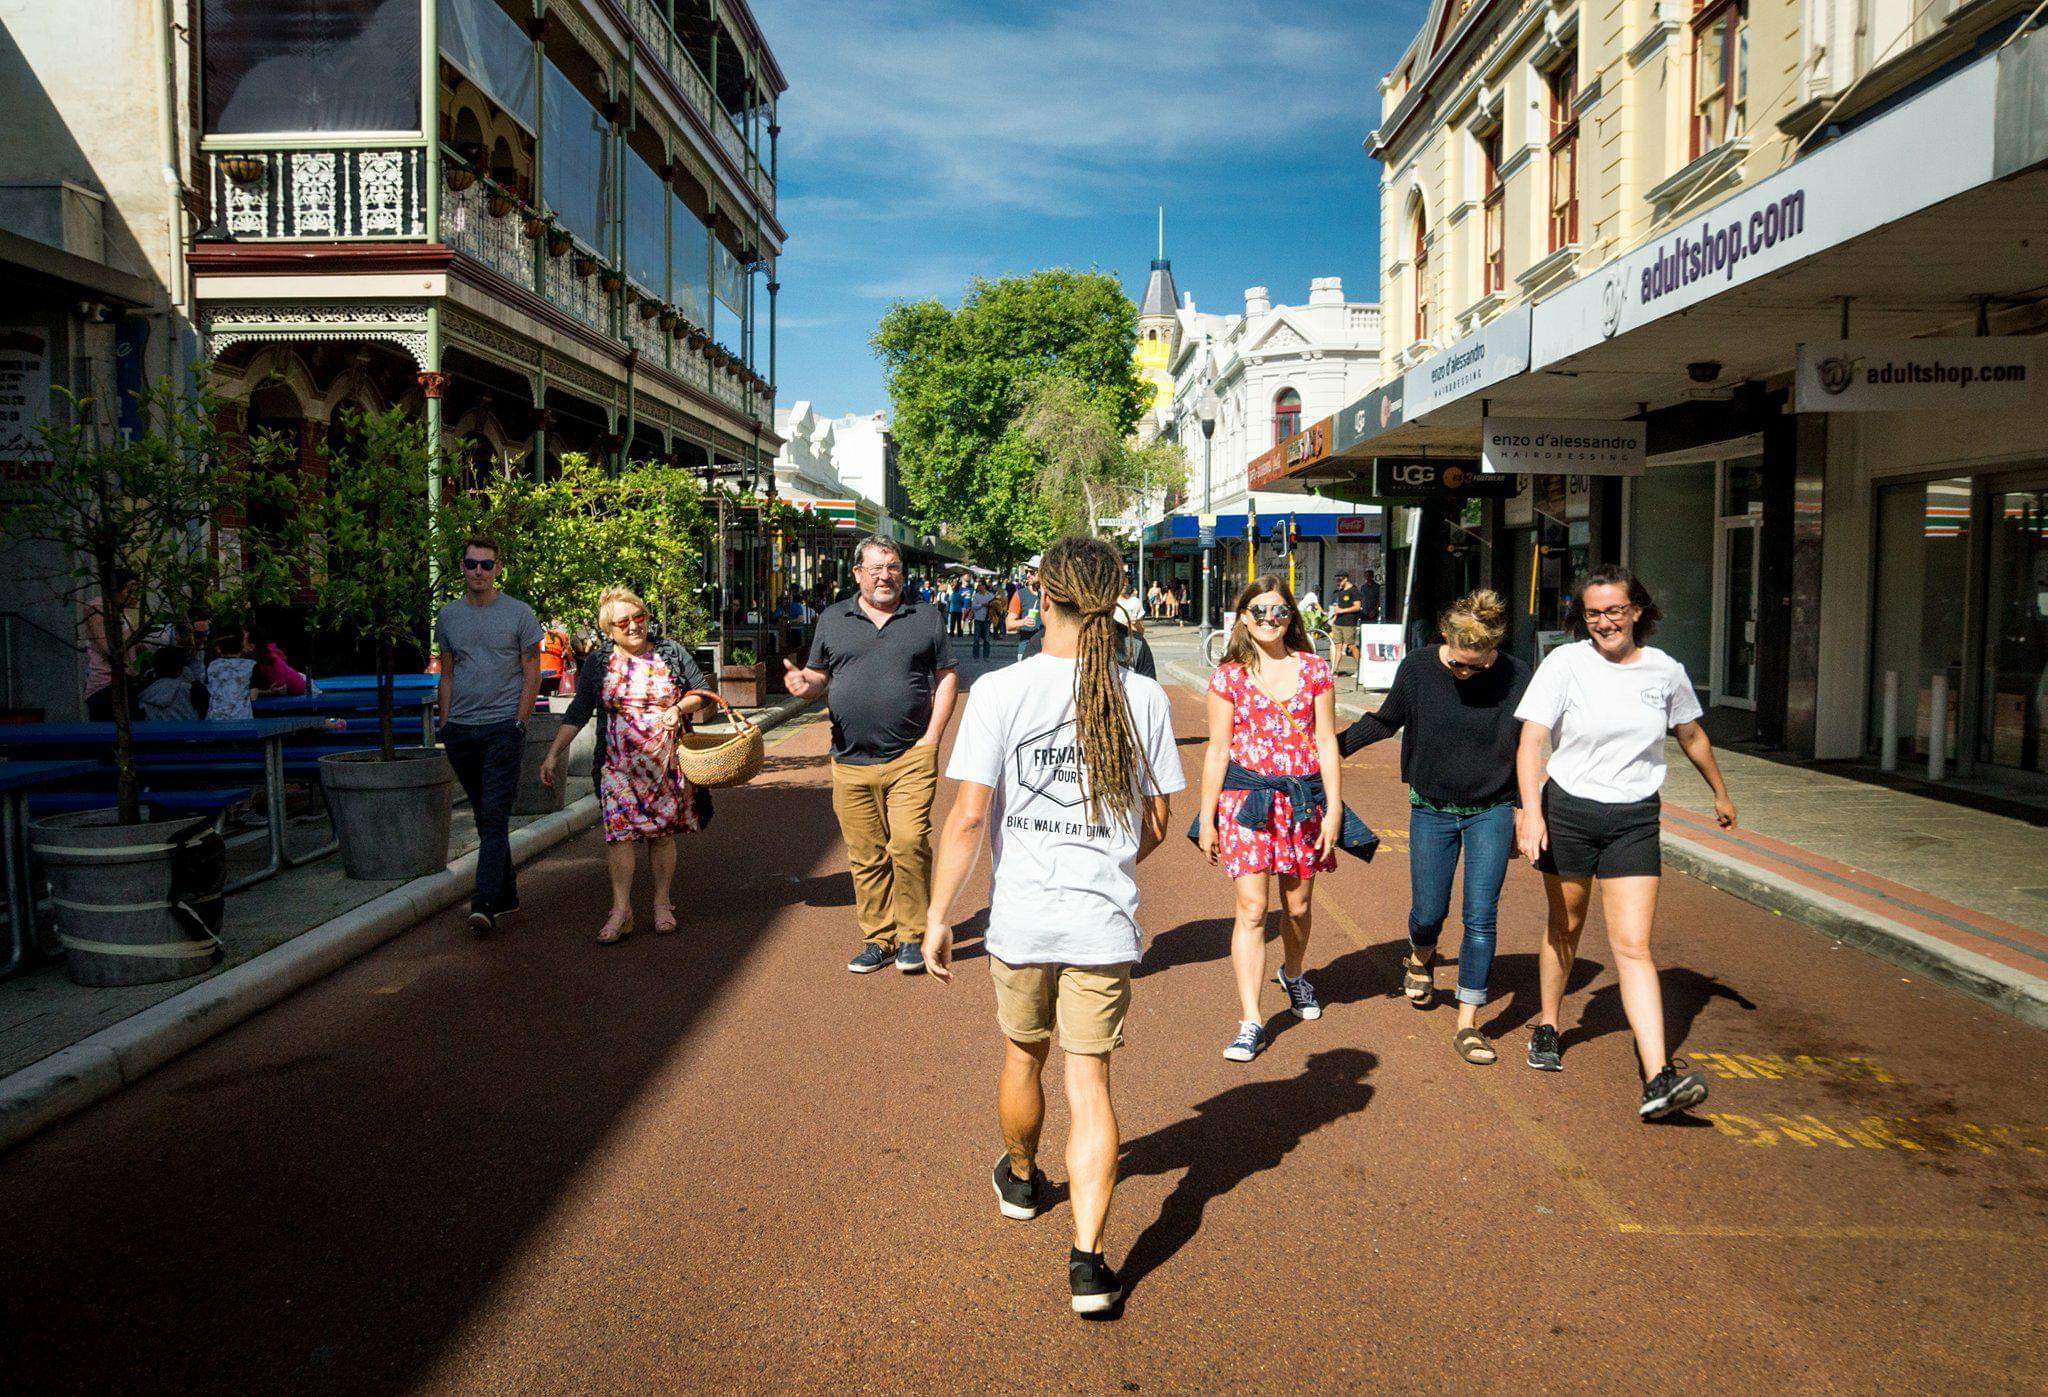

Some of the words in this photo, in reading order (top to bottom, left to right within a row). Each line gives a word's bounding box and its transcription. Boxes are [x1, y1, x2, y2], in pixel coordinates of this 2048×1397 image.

[1640, 188, 1806, 304] adultshop.com
[1431, 365, 1445, 384] enzo
[1446, 342, 1485, 376] d'alessandro
[1434, 369, 1482, 398] HAIRDRESSING
[1866, 362, 2026, 388] adultshop.com
[1492, 435, 1531, 447] enzo
[1535, 434, 1637, 450] d'alessandro
[1500, 452, 1629, 461] HAIRDRESSING
[1392, 464, 1436, 485] UGG
[1034, 746, 1086, 767] FREMAN
[1006, 815, 1030, 830] BIKE
[1034, 819, 1061, 834] WALK
[1065, 823, 1082, 836] EAT
